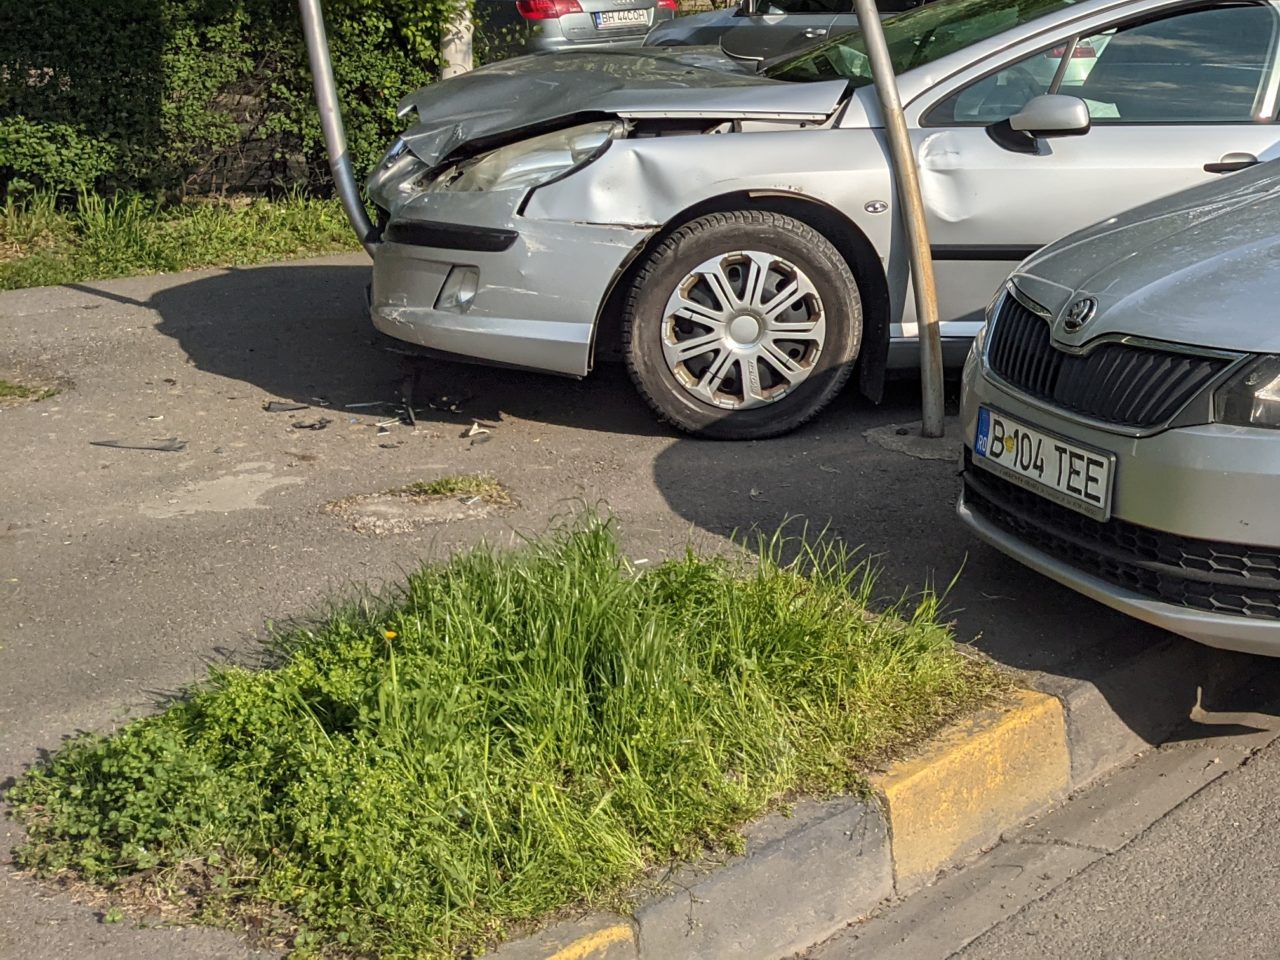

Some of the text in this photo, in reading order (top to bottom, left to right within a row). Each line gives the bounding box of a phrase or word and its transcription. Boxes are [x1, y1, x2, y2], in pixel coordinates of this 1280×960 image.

[989, 418, 1005, 459] B
[1013, 428, 1045, 478] 104
[1054, 443, 1104, 504] TEE
